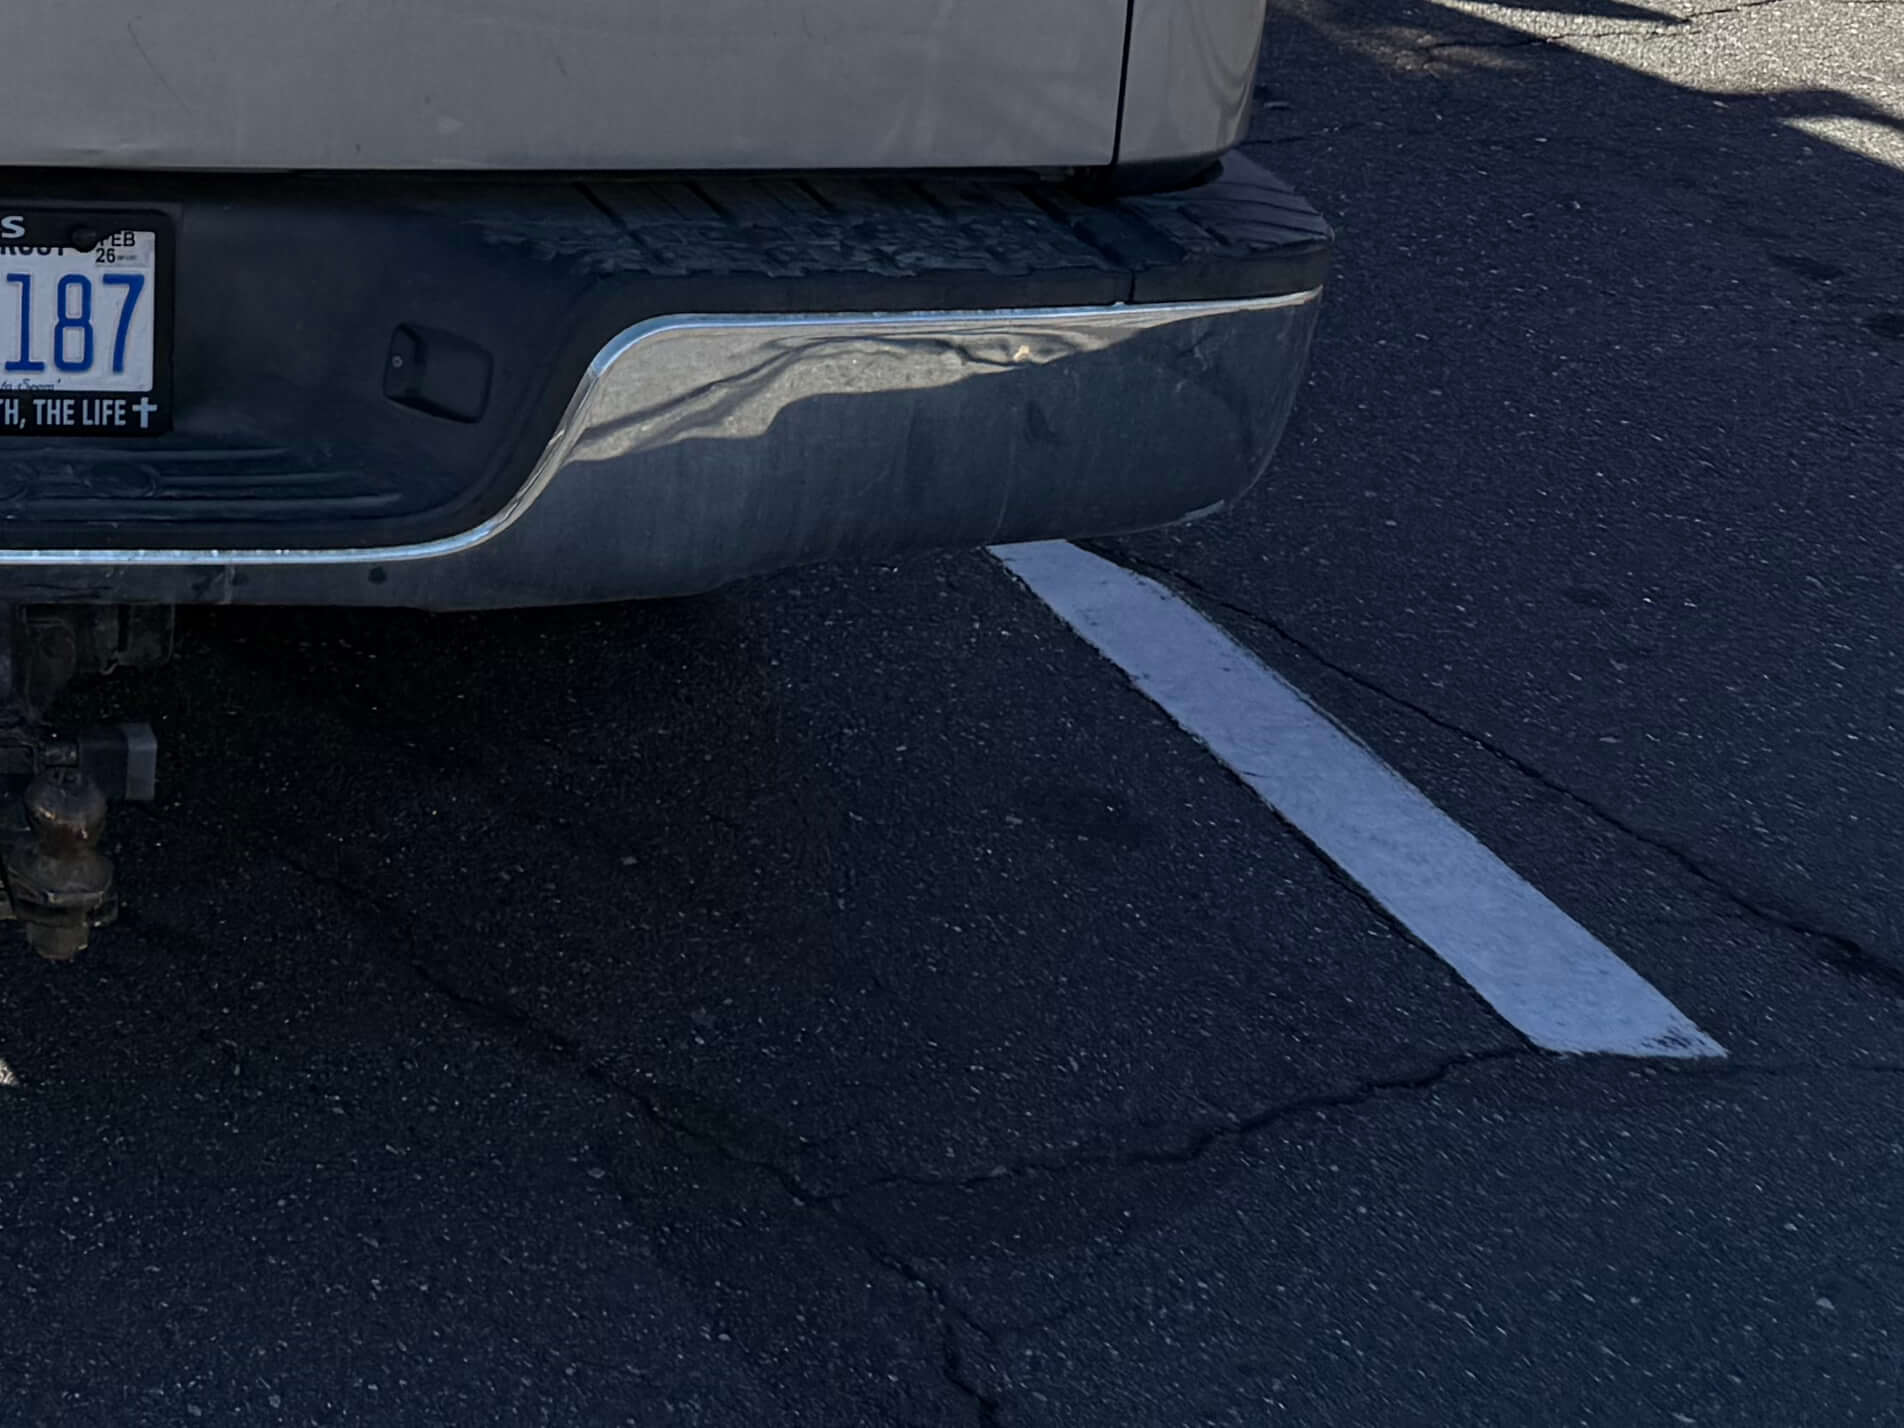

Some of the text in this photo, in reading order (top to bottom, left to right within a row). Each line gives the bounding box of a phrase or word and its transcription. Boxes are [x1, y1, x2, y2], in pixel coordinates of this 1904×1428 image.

[100, 231, 136, 247] EB
[95, 247, 116, 263] 26
[33, 398, 75, 426] THE
[81, 399, 127, 427] LIFE
